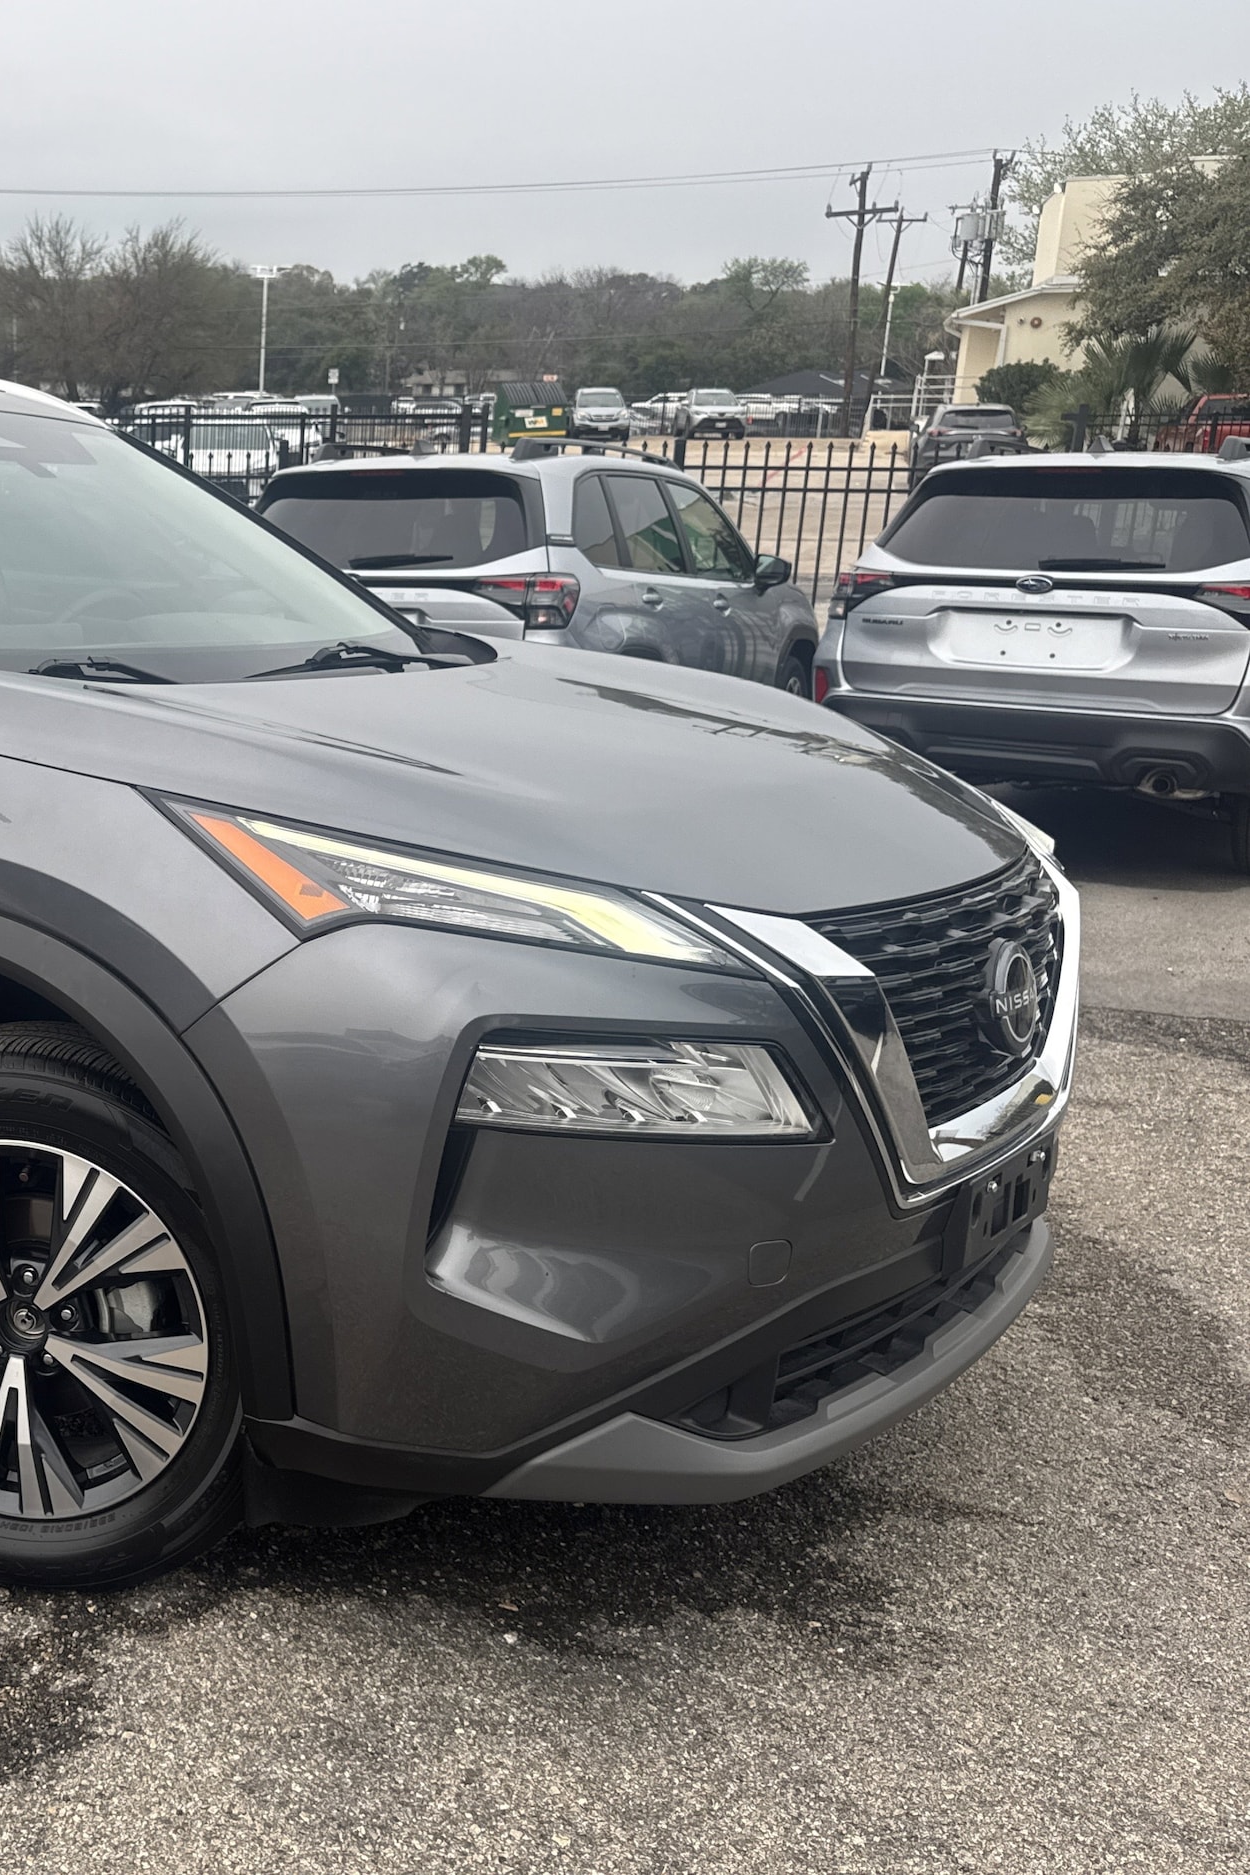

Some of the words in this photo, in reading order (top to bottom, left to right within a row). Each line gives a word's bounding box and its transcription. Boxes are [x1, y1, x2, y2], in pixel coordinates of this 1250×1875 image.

[932, 590, 1139, 606] FORESTER
[862, 618, 903, 626] SUBARU
[995, 987, 1034, 1014] NISSA
